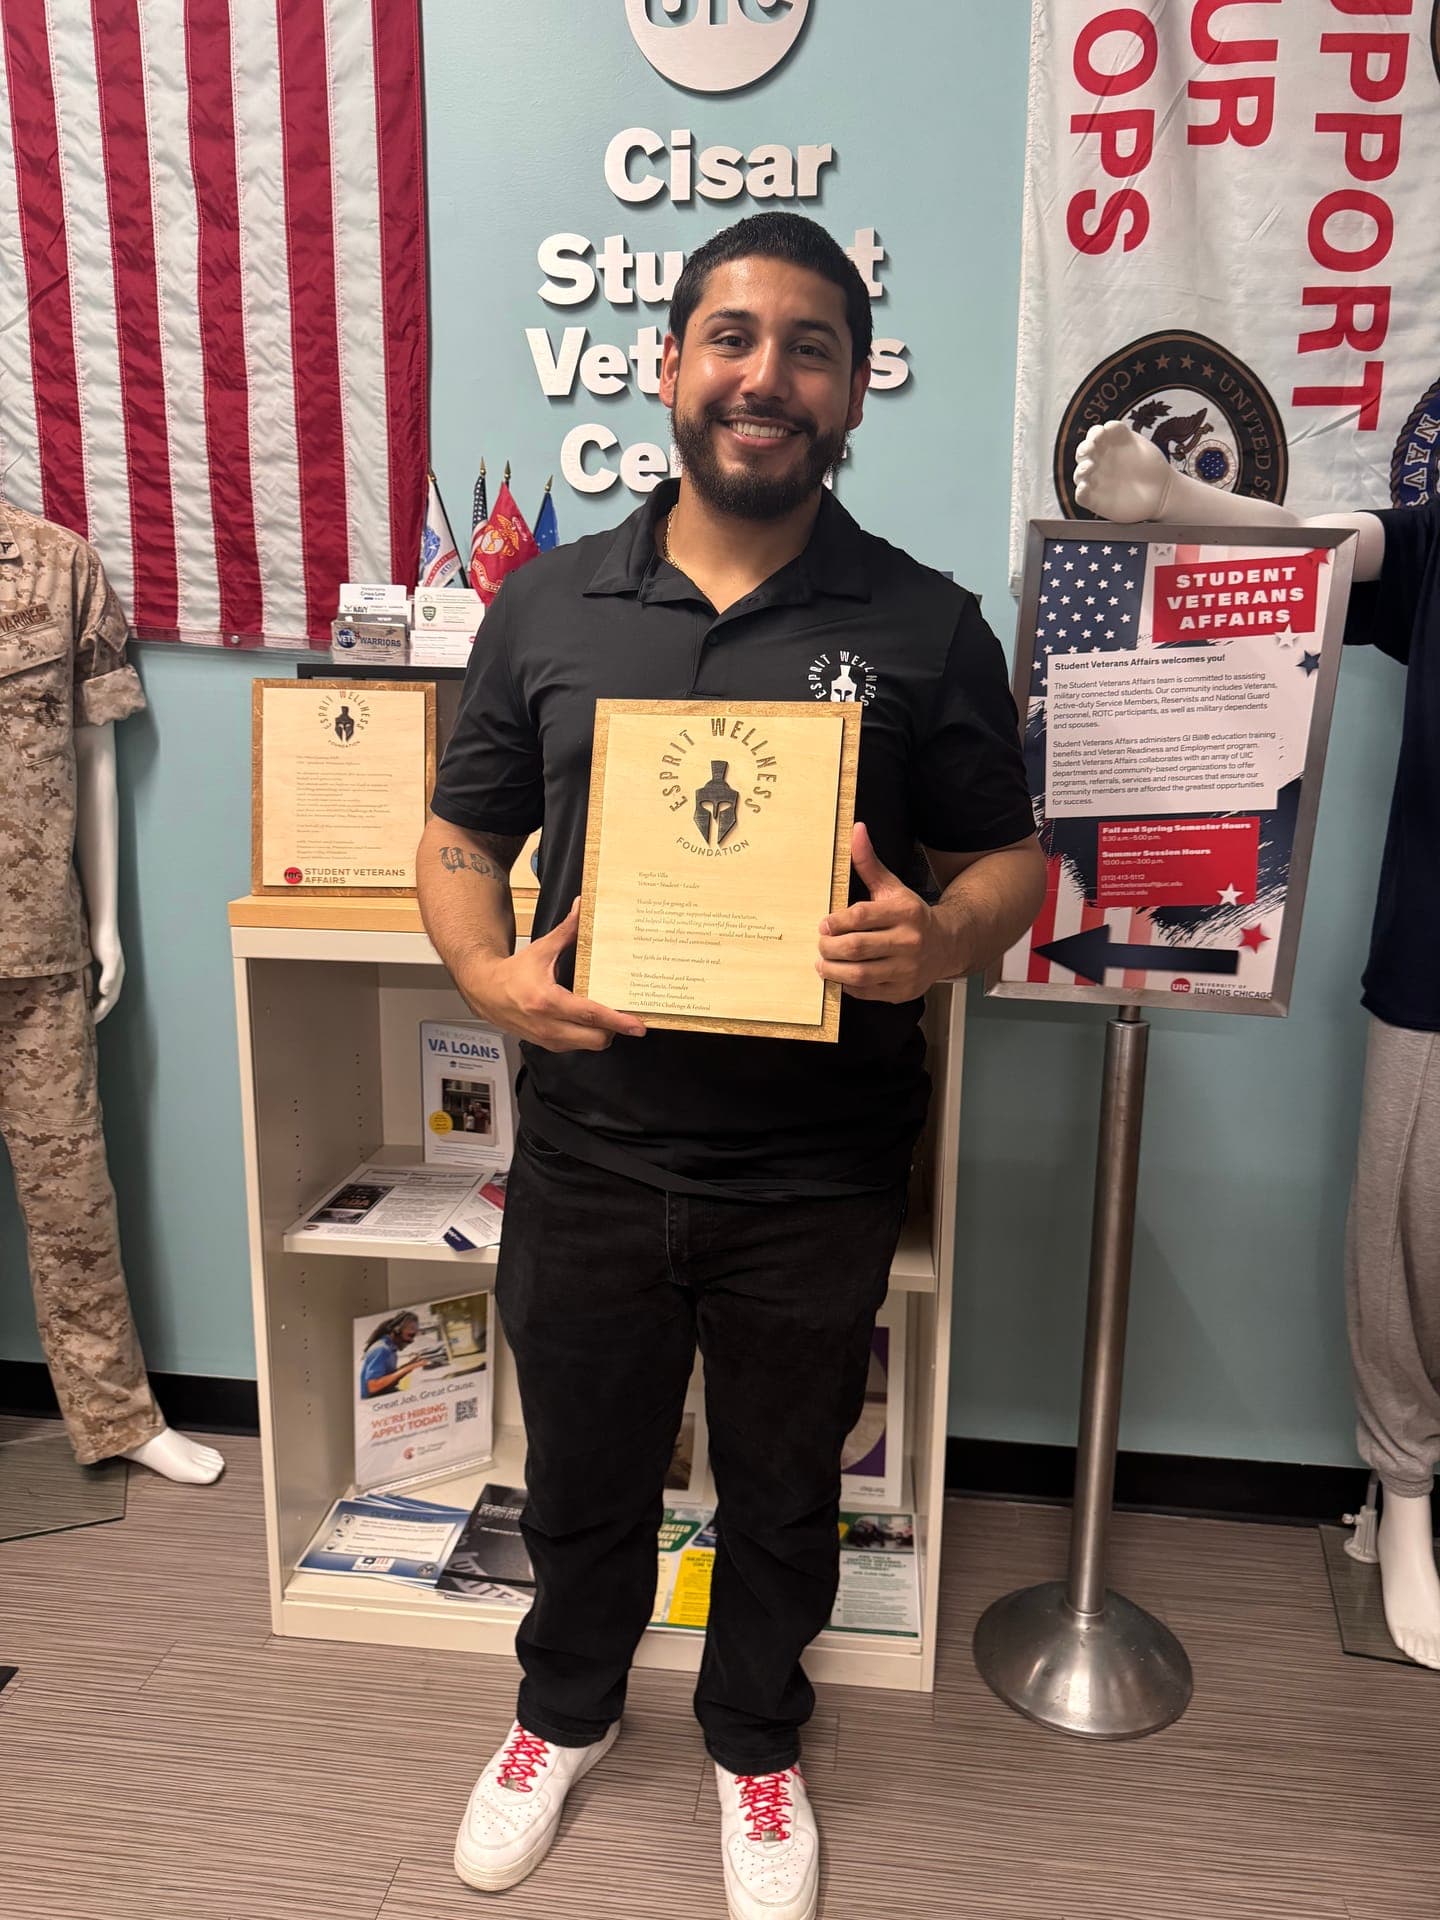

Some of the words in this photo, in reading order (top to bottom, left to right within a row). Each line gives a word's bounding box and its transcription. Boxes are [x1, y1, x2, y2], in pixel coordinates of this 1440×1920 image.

[604, 127, 833, 201] Cisar
[1291, 0, 1413, 431] PPORT
[537, 226, 884, 304] Stut
[525, 322, 910, 396] Vets
[1218, 372, 1272, 470] UNITED
[1176, 566, 1296, 589] STUDENT
[1167, 587, 1305, 610] VETERANS
[1179, 609, 1291, 630] AFFAIRS
[1054, 662, 1089, 670] Student
[1091, 660, 1128, 668] Veterans
[1130, 657, 1159, 666] Affairs
[1161, 656, 1205, 664] welcomes
[1206, 654, 1225, 664] you!
[808, 654, 831, 699] ESPRIT
[840, 650, 878, 706] WELLNESS
[1068, 680, 1097, 688] Student
[1131, 677, 1155, 685] Affairs
[1176, 675, 1182, 683] is
[1183, 674, 1224, 682] committed
[1233, 672, 1265, 680] assisting
[1053, 692, 1079, 700] military
[1081, 689, 1119, 698] connected
[1170, 685, 1210, 693] community
[1053, 701, 1095, 709] Active-duty
[1161, 695, 1199, 703] Reservists
[1200, 694, 1214, 702] and
[1215, 692, 1246, 701] National
[1246, 691, 1270, 699] Guard
[1091, 709, 1113, 717] ROTC
[1196, 704, 1223, 712] military
[1223, 702, 1268, 711] dependents
[1053, 740, 1081, 748] Student
[1053, 749, 1081, 757] benefits
[1126, 746, 1163, 754] Readiness
[1180, 743, 1225, 752] Employment
[659, 729, 695, 812] ESPRIT
[711, 718, 777, 814] WELLNESS
[1053, 759, 1081, 767] Student
[1138, 755, 1182, 763] collaborates
[1053, 769, 1098, 777] departments
[1098, 767, 1113, 775] and
[1113, 766, 1178, 774] community-based
[1179, 763, 1227, 772] organizations
[1121, 775, 1151, 783] services
[1053, 788, 1091, 796] community
[1185, 783, 1214, 792] greatest
[1216, 781, 1264, 790] opportunities
[1141, 825, 1172, 833] Spring
[676, 837, 750, 857] FOUNDATION
[304, 868, 350, 876] STUDENT
[353, 868, 406, 876] VETERANS
[304, 876, 346, 884] AFFAIRS
[1172, 983, 1189, 991] UIC
[1194, 988, 1231, 997] ILLINOIS
[428, 1038, 448, 1052] VA
[451, 1041, 500, 1059] LOANS
[372, 1399, 399, 1412] Great
[420, 1387, 445, 1399] Great
[371, 1413, 407, 1429] WE'RE
[371, 1423, 405, 1440] APPLY
[408, 1412, 448, 1429] TODAY!
